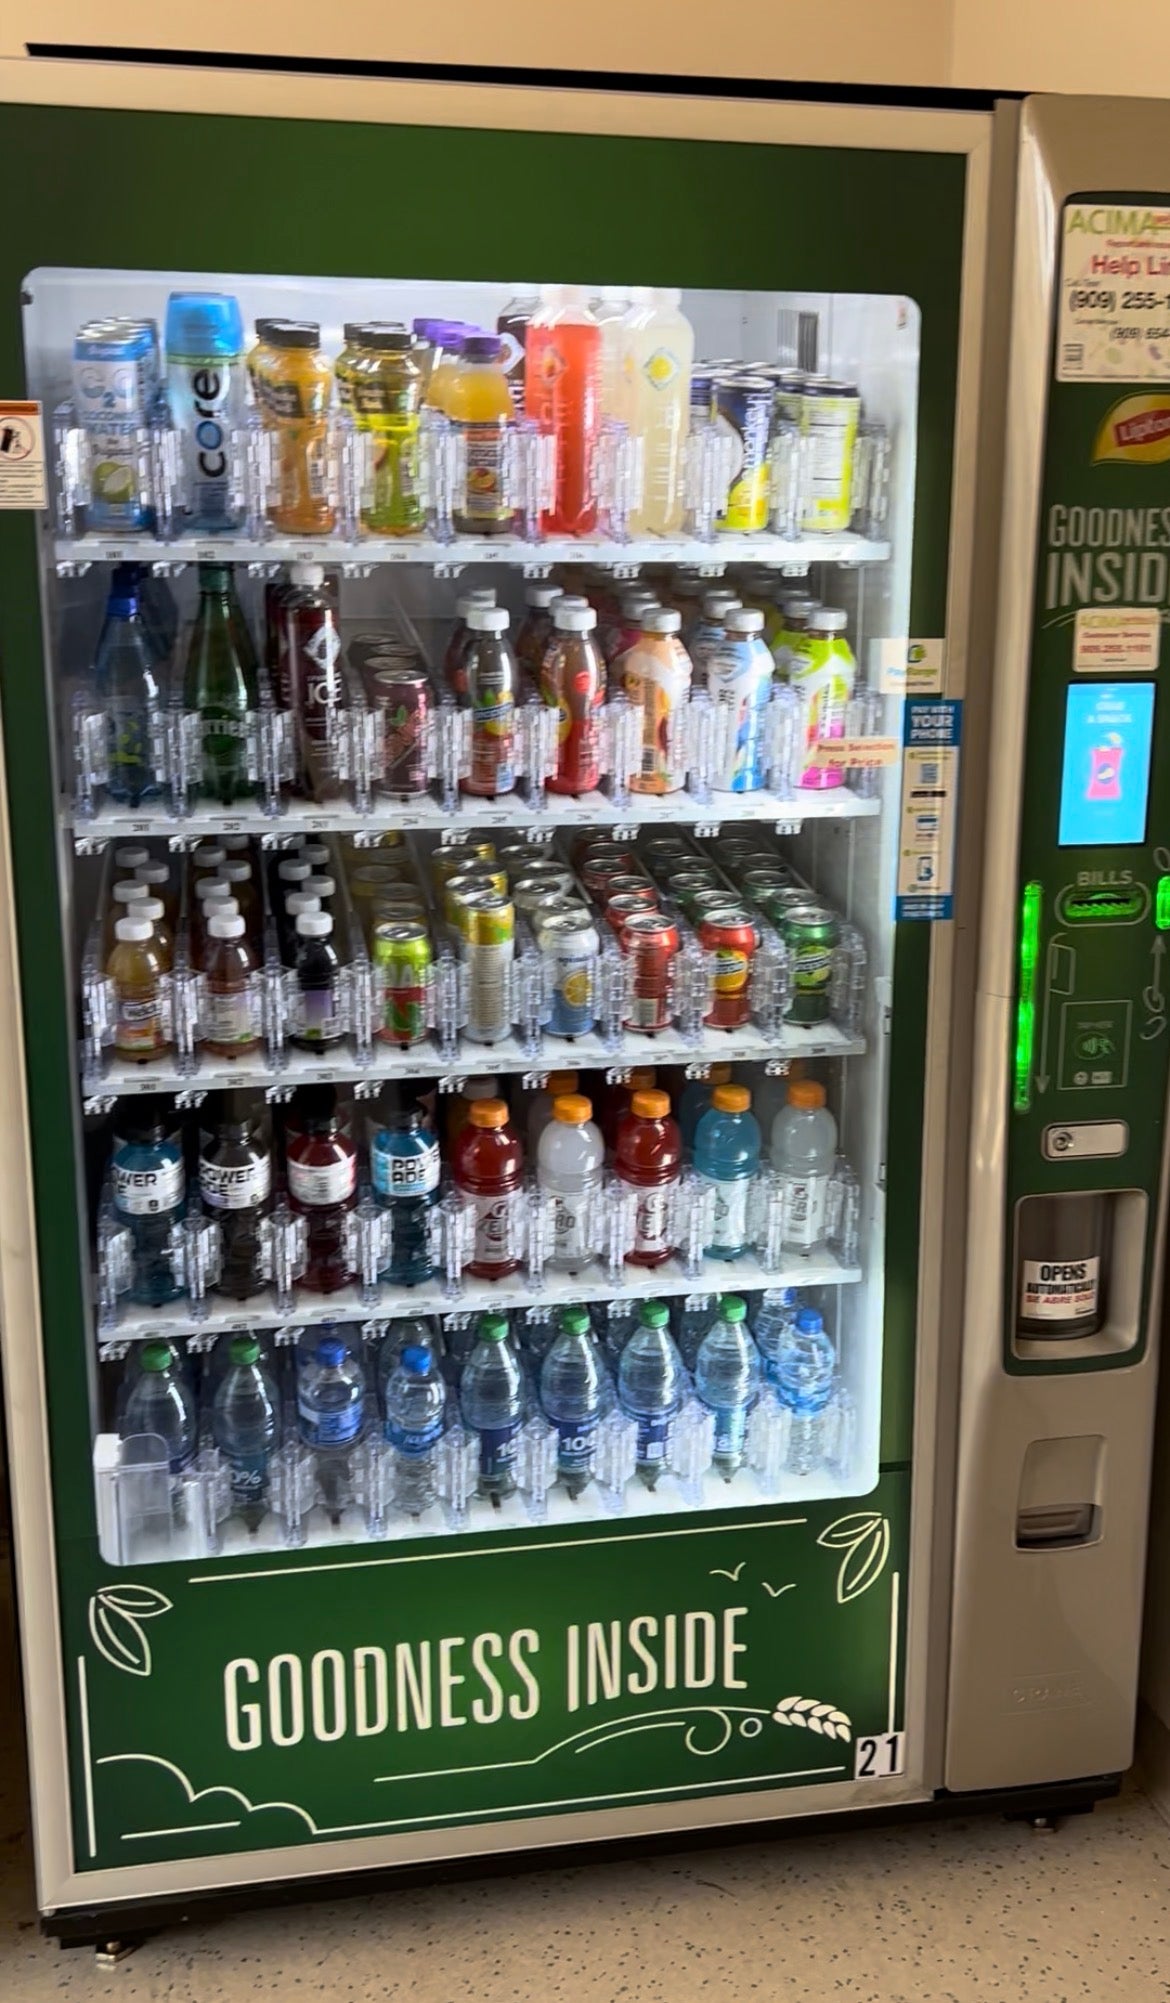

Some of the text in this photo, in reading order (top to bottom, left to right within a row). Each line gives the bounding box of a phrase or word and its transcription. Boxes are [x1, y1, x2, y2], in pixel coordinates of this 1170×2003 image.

[1091, 255, 1140, 279] Help
[1069, 290, 1116, 312] (909)
[193, 368, 227, 478] core
[911, 714, 954, 728] YOUR
[1077, 870, 1133, 886] BILLS
[1040, 1264, 1087, 1281] OPENS
[224, 1607, 749, 1751] GOODNESS INSIDE
[858, 1735, 898, 1776] 21
